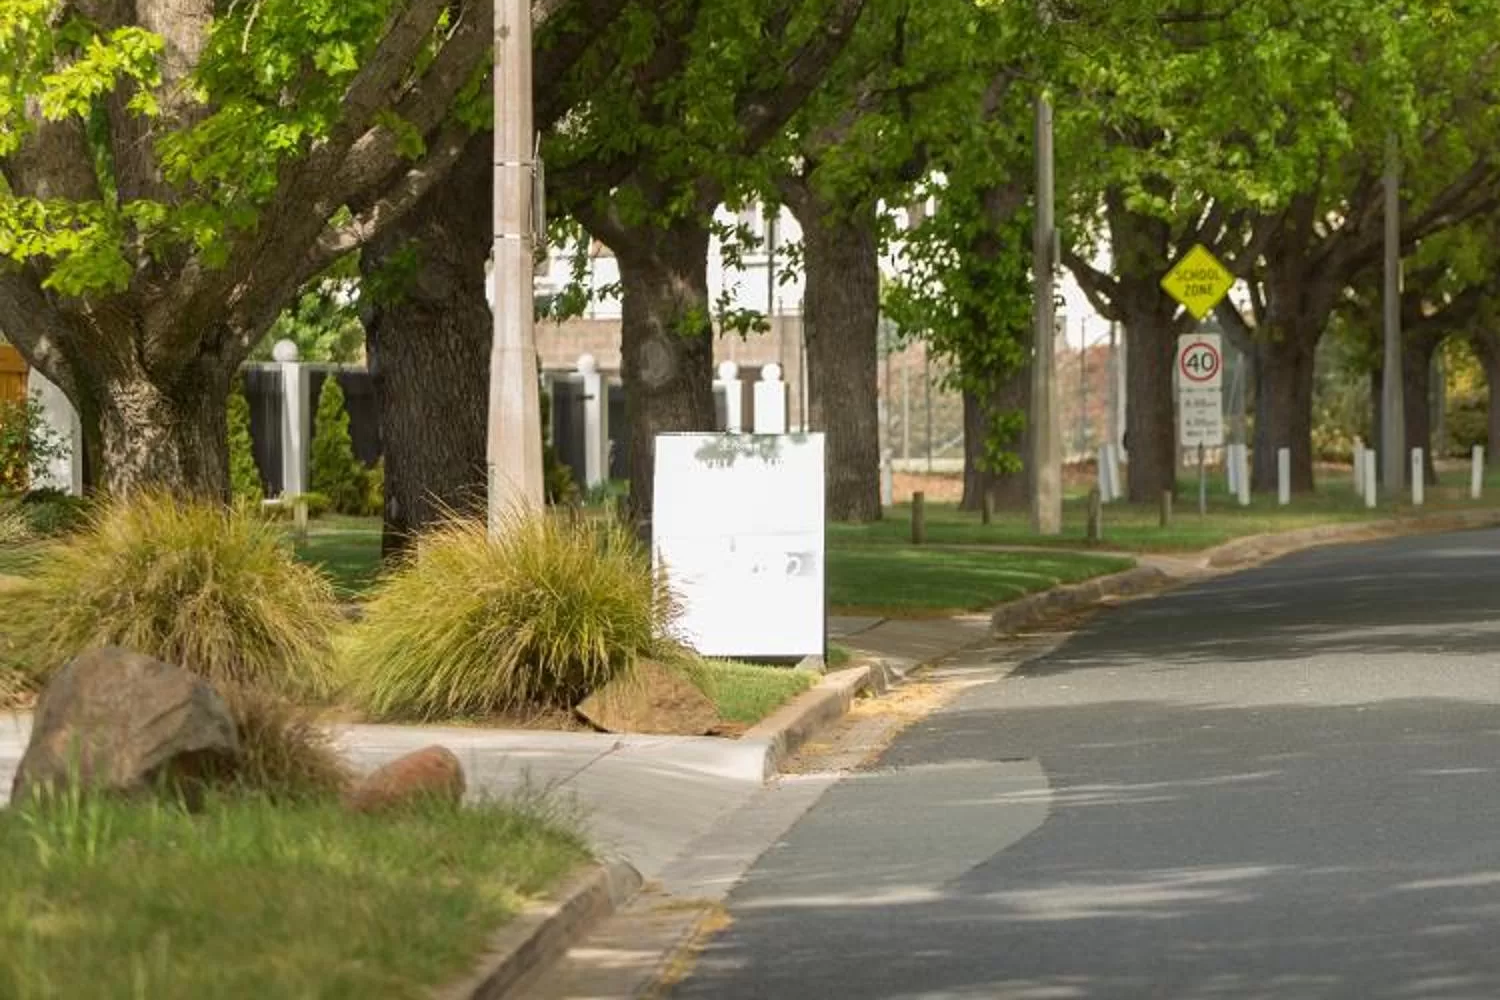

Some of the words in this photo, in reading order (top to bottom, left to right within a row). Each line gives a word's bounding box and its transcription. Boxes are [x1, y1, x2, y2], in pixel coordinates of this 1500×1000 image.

[1175, 268, 1220, 281] SCHOOL
[1183, 283, 1213, 297] ZONE
[1186, 352, 1214, 372] 40
